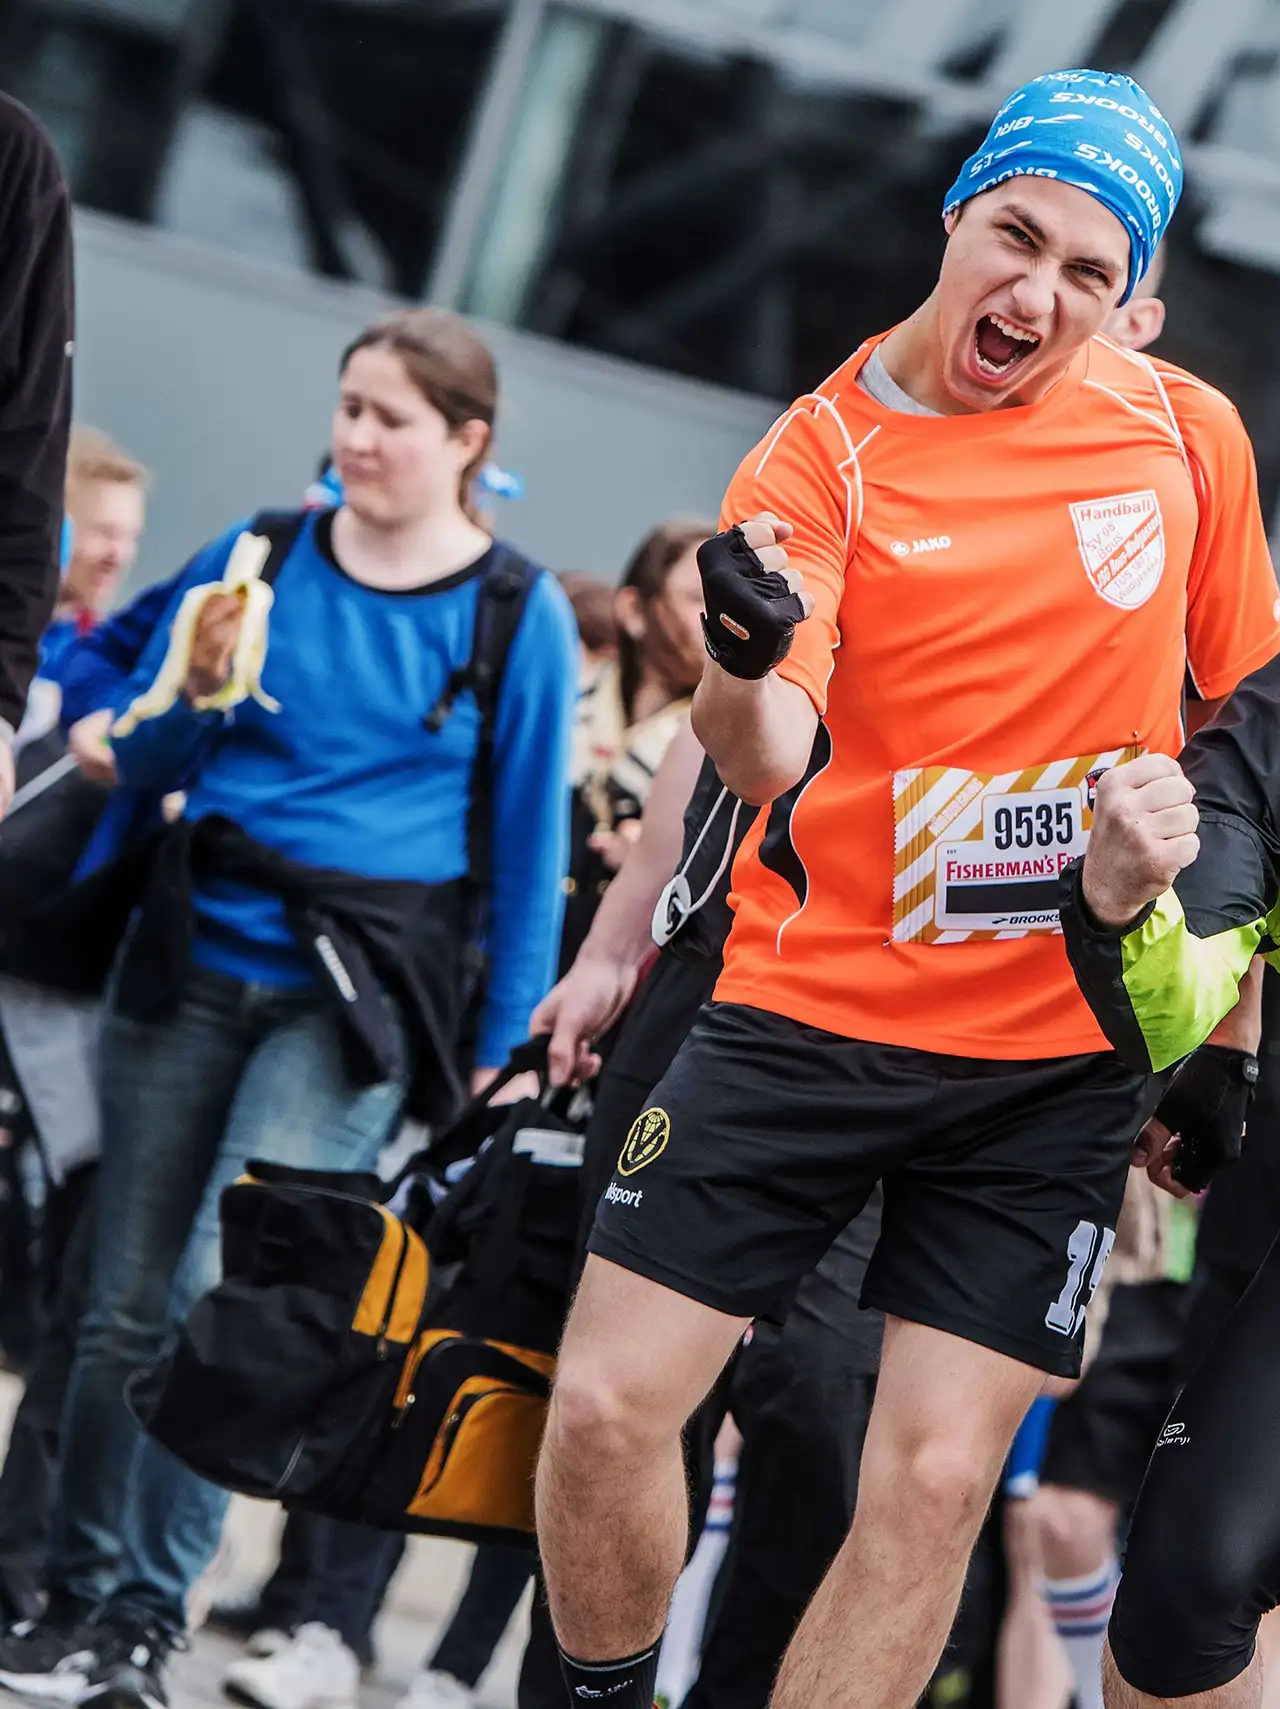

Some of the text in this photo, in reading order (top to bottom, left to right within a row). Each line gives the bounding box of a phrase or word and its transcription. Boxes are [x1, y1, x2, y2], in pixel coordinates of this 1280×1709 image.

[1049, 92, 1167, 149] BROOKS
[1074, 142, 1162, 230] BROOKS
[1080, 499, 1151, 521] Handball
[912, 536, 951, 553] JAKO
[994, 802, 1073, 850] 9535
[946, 854, 1054, 882] FISHERMAN'S
